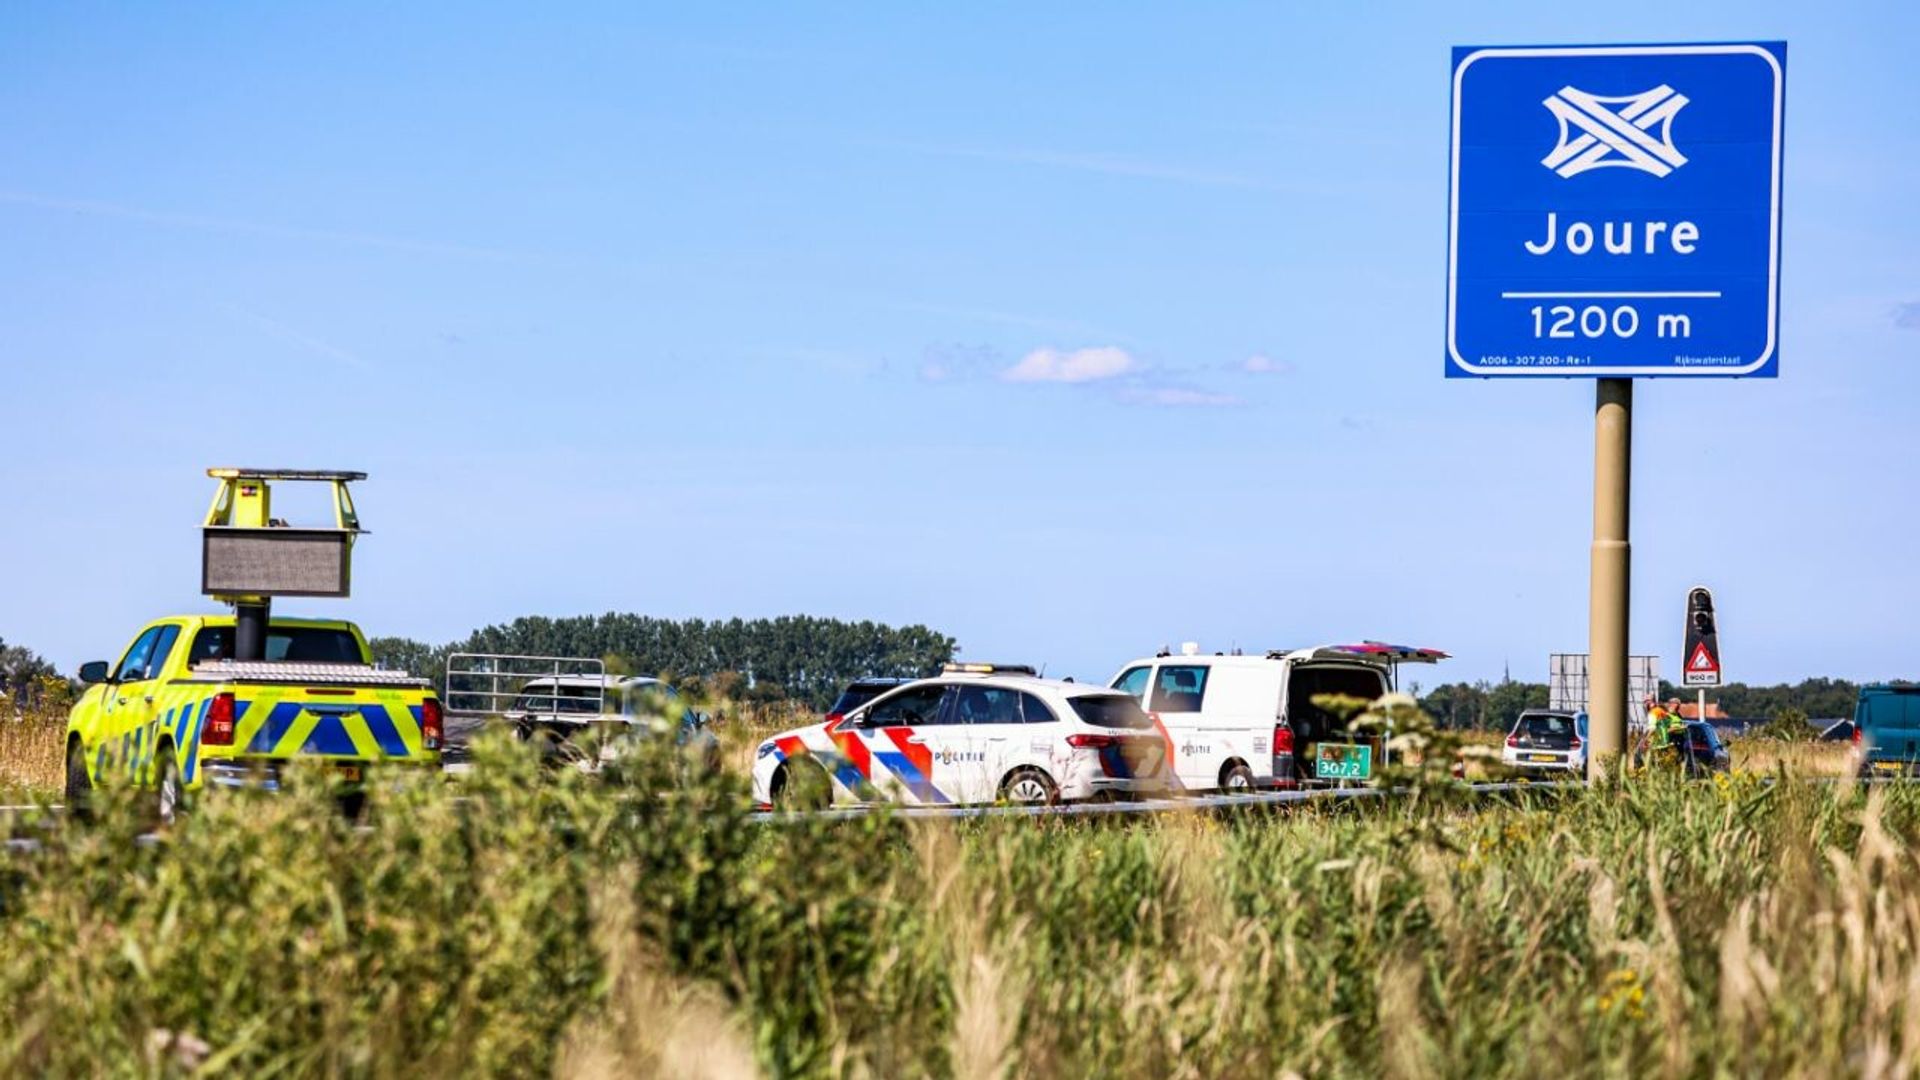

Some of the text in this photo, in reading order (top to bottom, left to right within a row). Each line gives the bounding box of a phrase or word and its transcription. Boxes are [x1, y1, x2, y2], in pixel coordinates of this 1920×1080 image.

[1524, 212, 1699, 255] Joure
[1531, 305, 1691, 338] 1200 m
